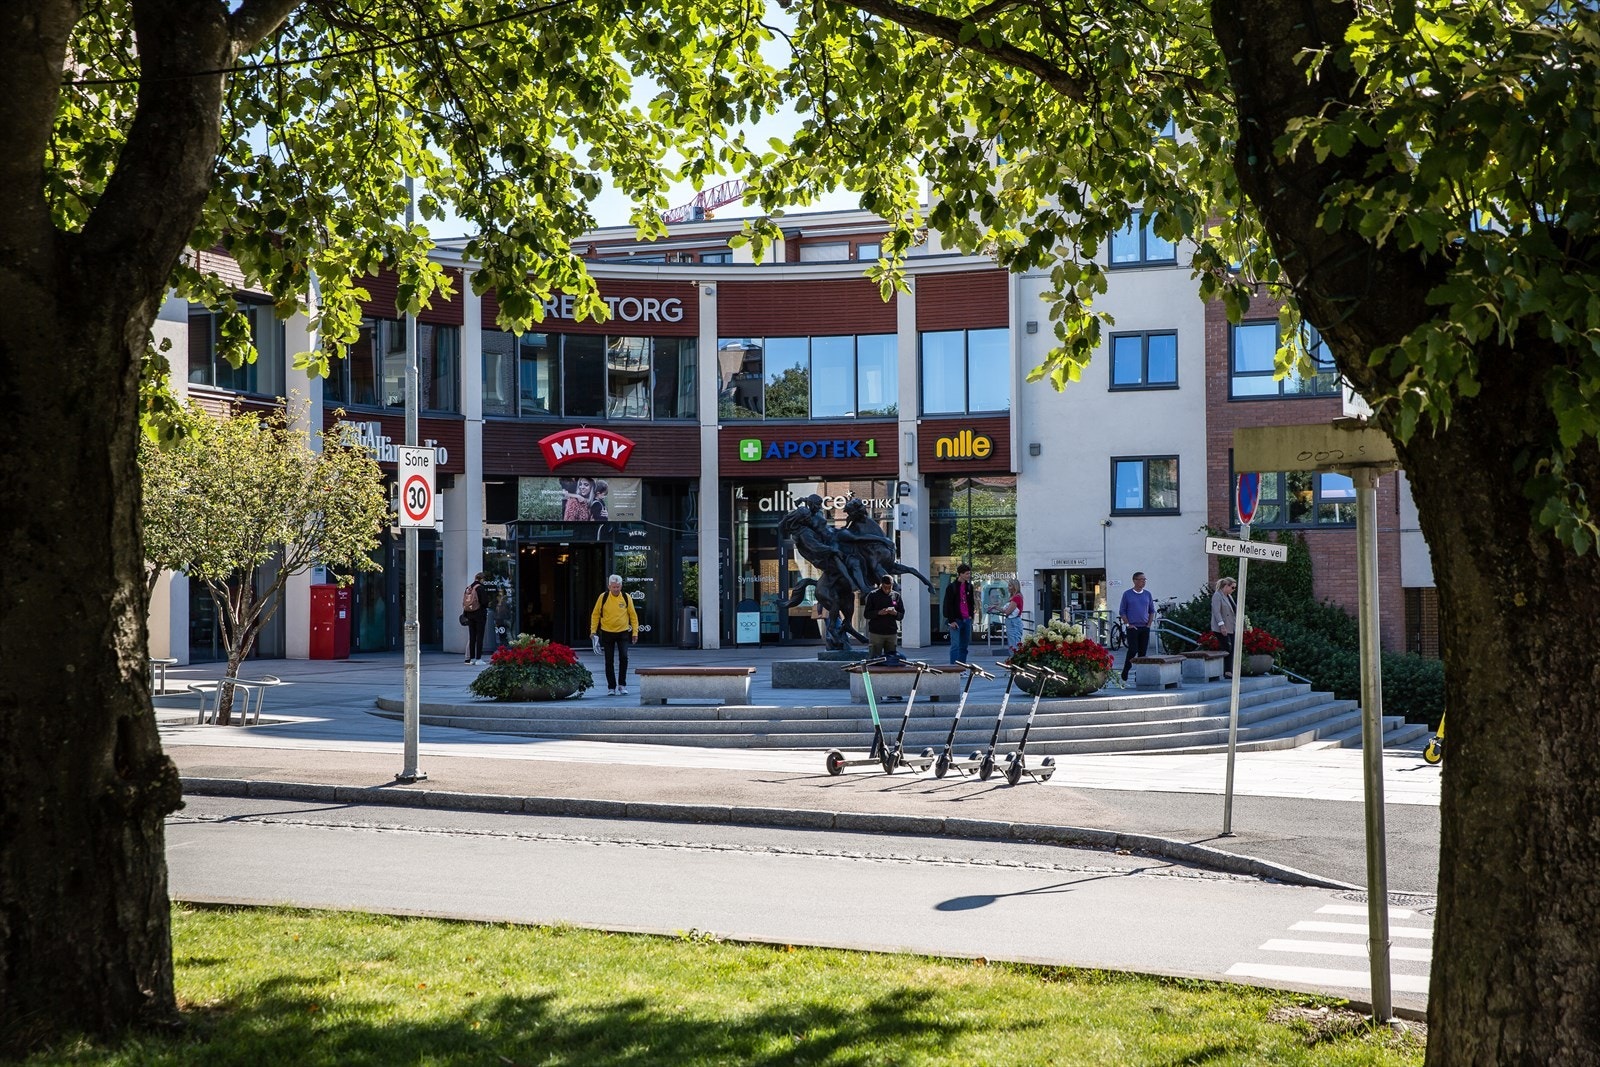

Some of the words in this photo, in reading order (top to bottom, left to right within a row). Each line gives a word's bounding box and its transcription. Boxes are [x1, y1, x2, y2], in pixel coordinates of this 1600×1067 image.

[603, 296, 683, 322] TORG
[551, 436, 628, 460] MENY
[765, 439, 861, 460] APOTEK
[865, 438, 878, 458] 1
[935, 429, 992, 459] nille
[404, 452, 429, 467] Sone
[408, 486, 426, 510] 30
[758, 490, 847, 512] allice
[861, 498, 893, 509] PTIKK
[628, 530, 647, 538] MENY
[1211, 540, 1236, 553] Peter
[1239, 543, 1267, 556] Møllers
[1270, 549, 1282, 558] vei
